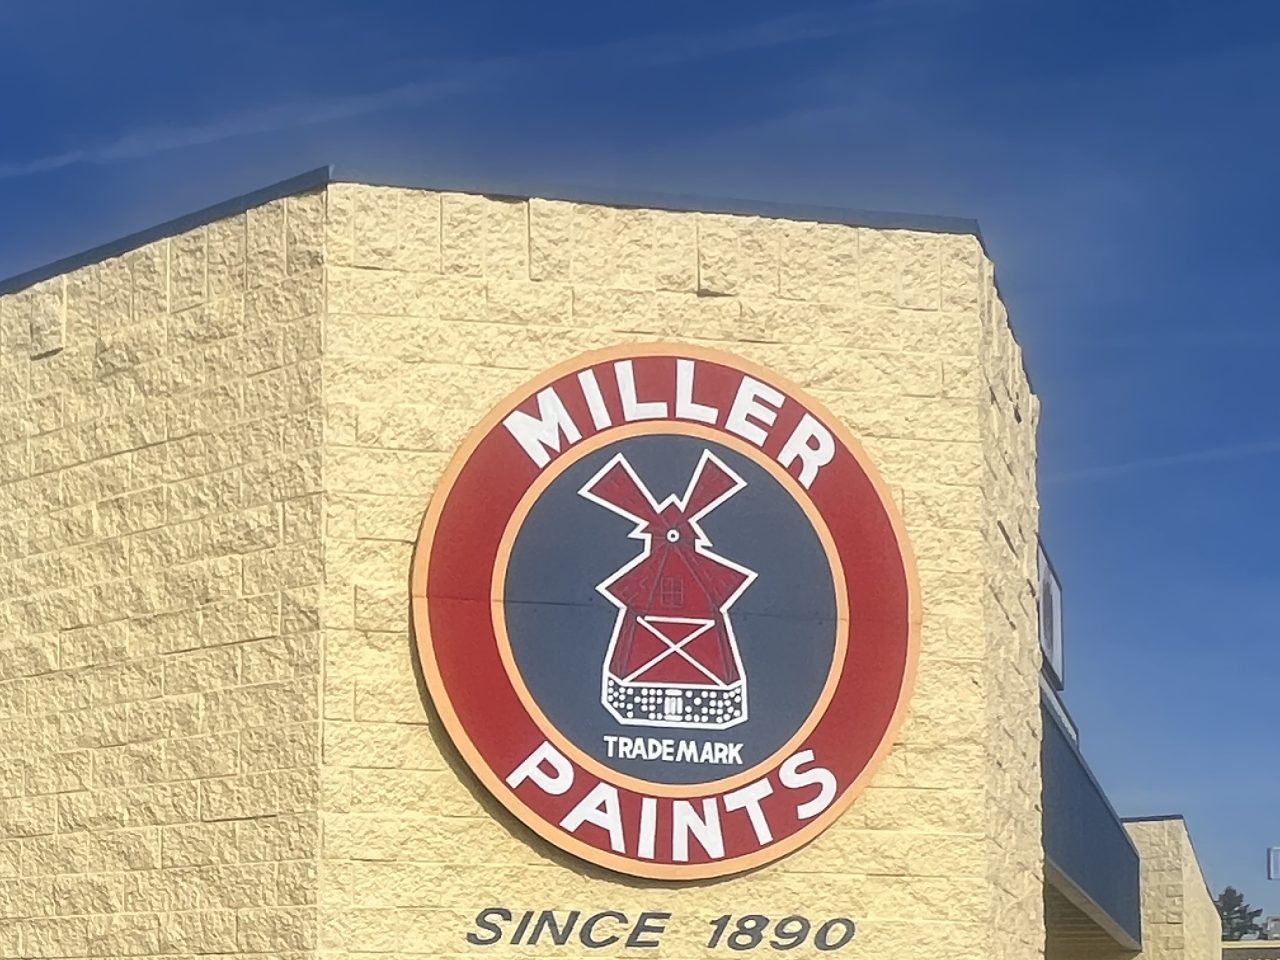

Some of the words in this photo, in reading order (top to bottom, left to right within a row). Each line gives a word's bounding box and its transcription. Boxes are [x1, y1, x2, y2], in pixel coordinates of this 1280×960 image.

[502, 359, 838, 490] MILLER
[603, 735, 744, 766] TRADEMARK
[506, 740, 838, 862] PAINTS
[466, 907, 672, 949] SINCE
[707, 913, 857, 951] 1890
